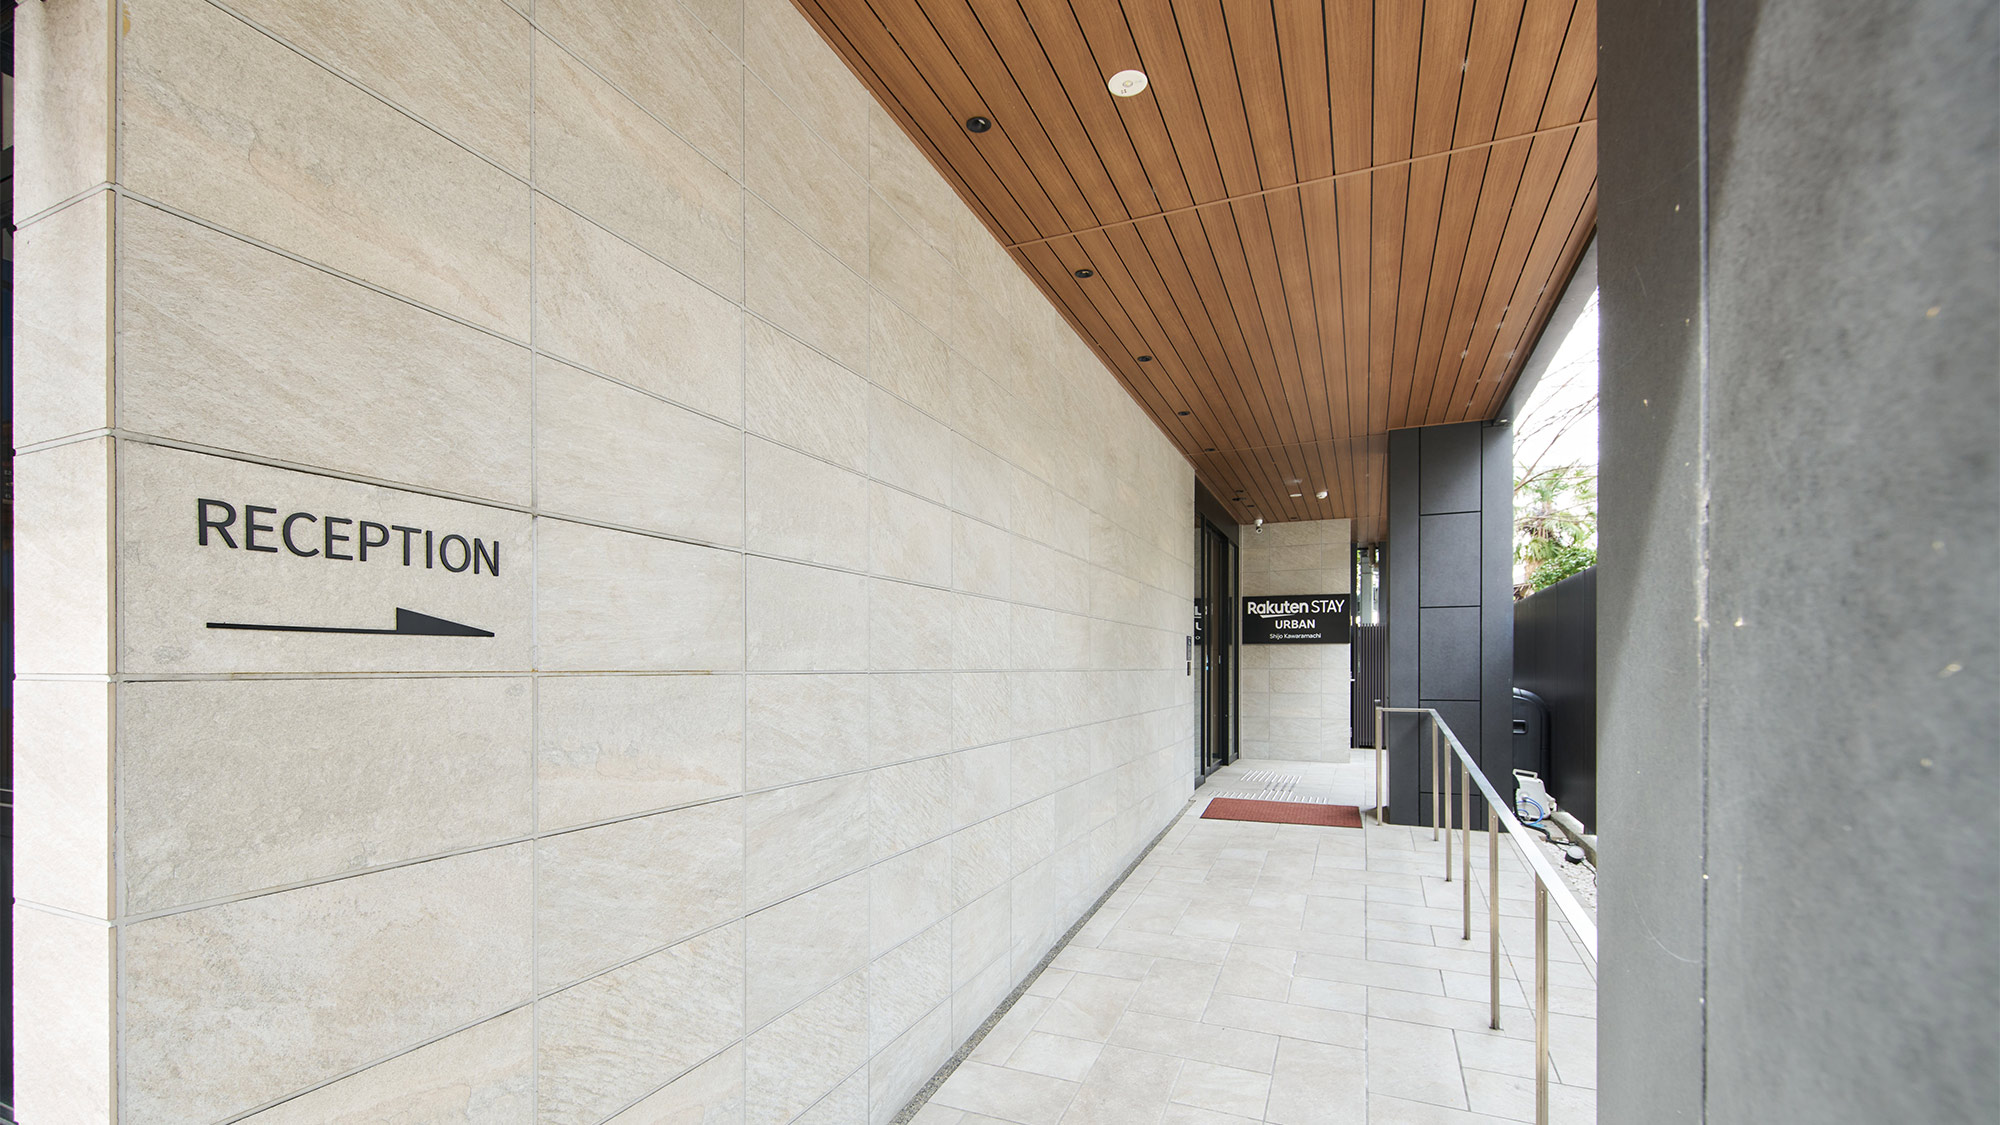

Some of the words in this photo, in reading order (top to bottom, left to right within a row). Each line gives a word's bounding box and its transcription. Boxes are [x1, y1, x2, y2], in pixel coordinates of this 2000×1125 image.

[197, 497, 500, 577] RECEPTION
[1247, 600, 1309, 615] Rakuten
[1310, 599, 1345, 614] STAY
[1275, 619, 1316, 629] URBAN
